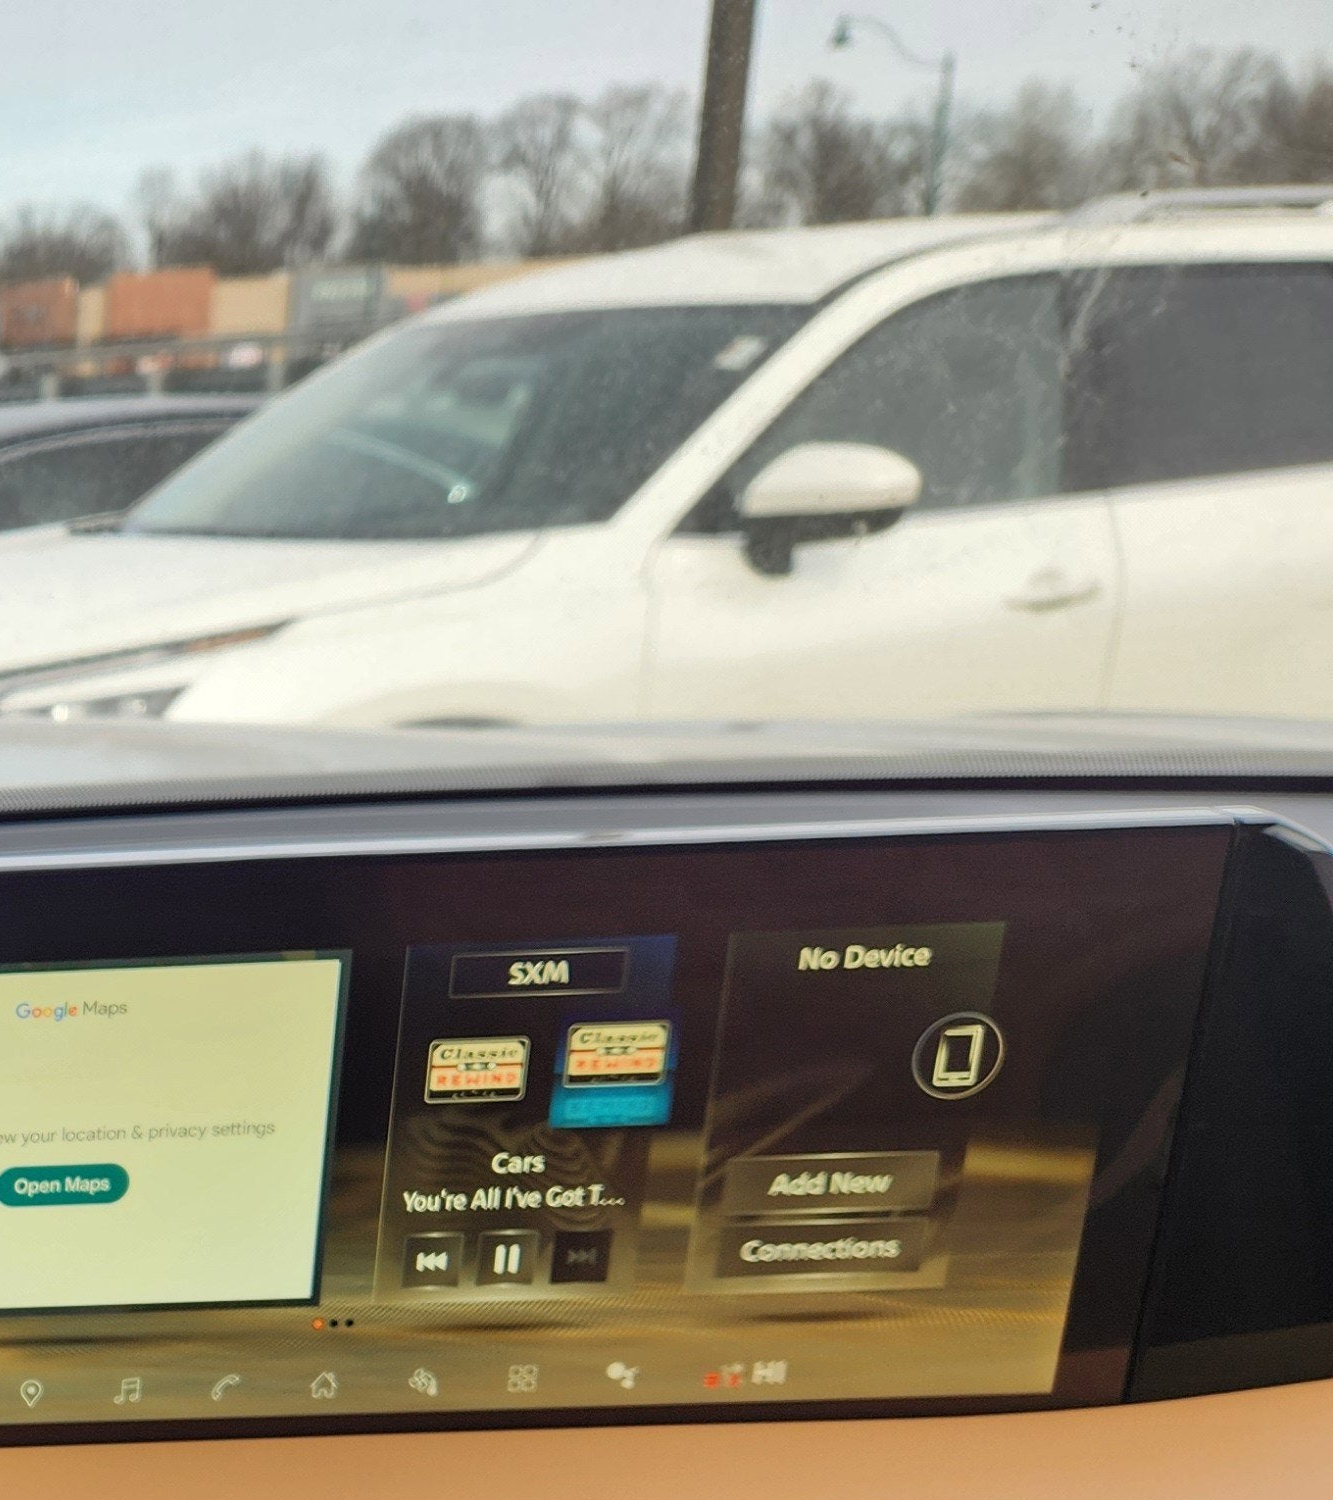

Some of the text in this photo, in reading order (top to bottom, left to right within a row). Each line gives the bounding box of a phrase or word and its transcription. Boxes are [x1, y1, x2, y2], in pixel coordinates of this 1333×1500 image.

[797, 943, 932, 971] No Device
[507, 960, 570, 985] SXM
[15, 1000, 128, 1022] Google Maps
[578, 1031, 659, 1044] Classic
[440, 1046, 520, 1060] Classic
[436, 1072, 519, 1087] REWIND
[20, 1129, 57, 1147] your
[61, 1126, 126, 1142] location
[131, 1126, 144, 1140] &
[148, 1123, 207, 1141] privacy
[212, 1119, 276, 1139] settings
[491, 1152, 546, 1174] Cars
[14, 1175, 111, 1197] Open Maps
[767, 1171, 894, 1197] Add New
[403, 1188, 467, 1213] You're
[470, 1186, 501, 1210] All
[505, 1185, 543, 1209] I've
[545, 1185, 586, 1208] Got
[740, 1236, 902, 1263] Connections
